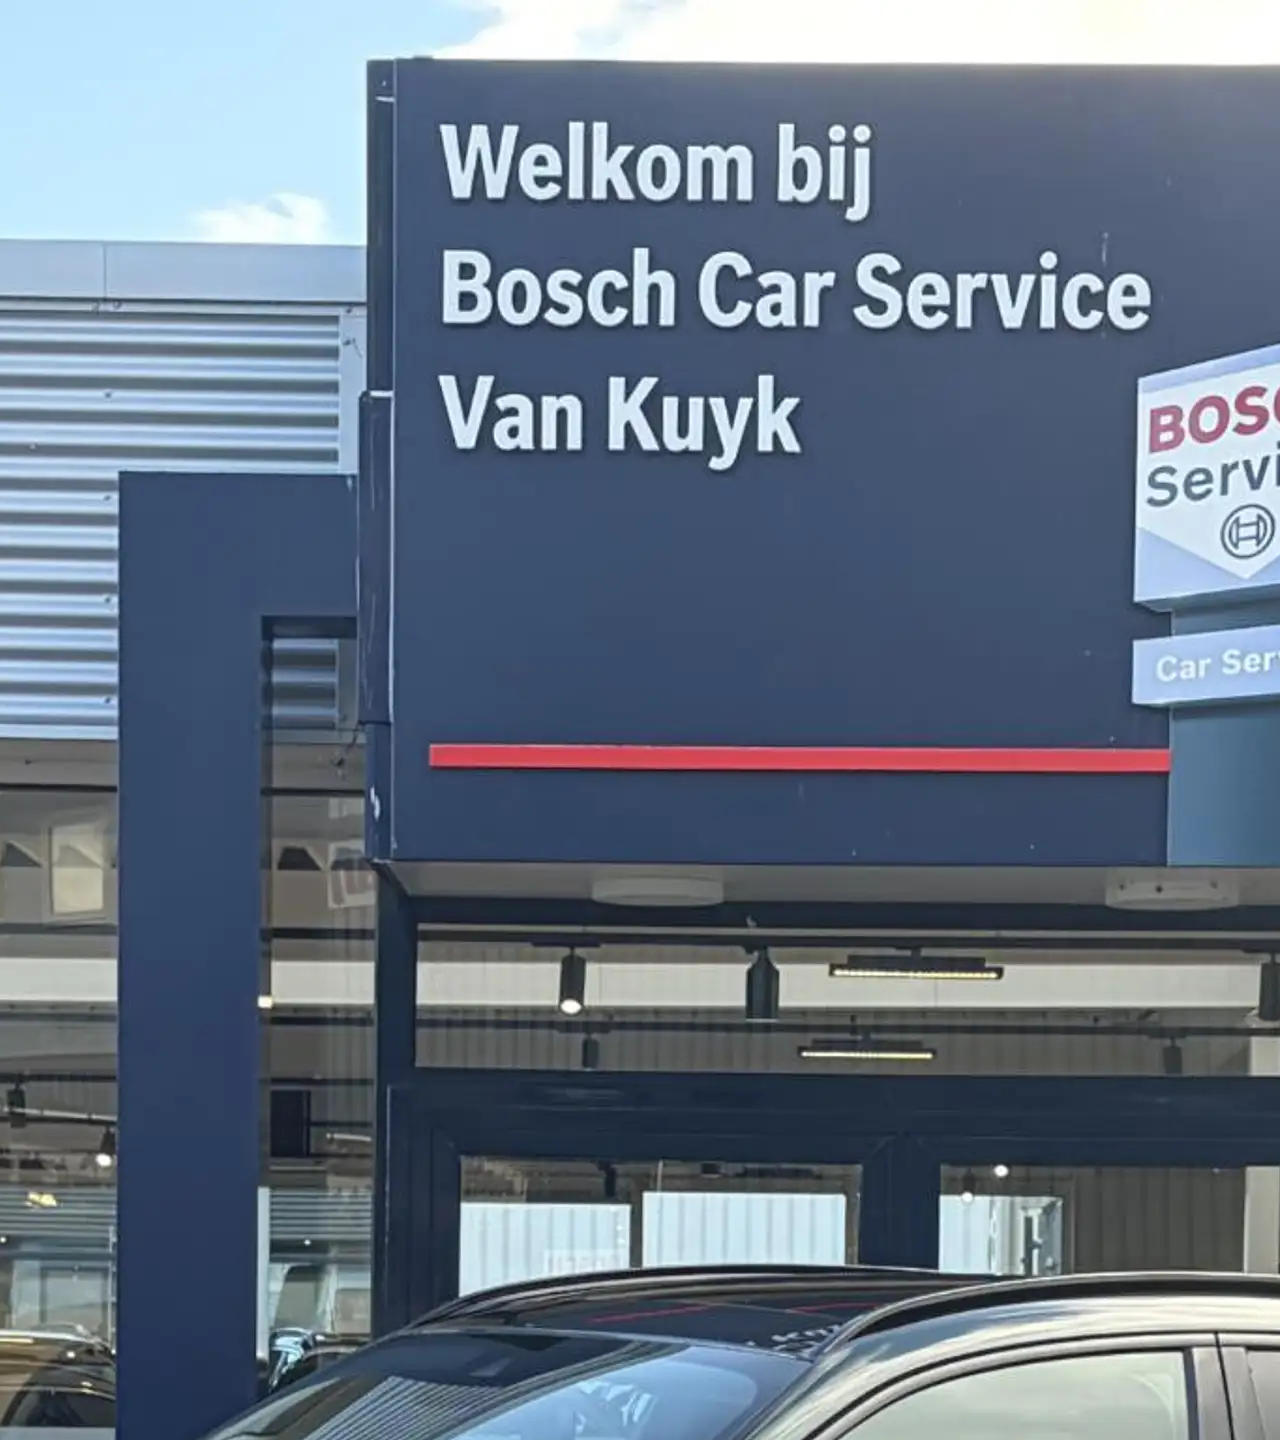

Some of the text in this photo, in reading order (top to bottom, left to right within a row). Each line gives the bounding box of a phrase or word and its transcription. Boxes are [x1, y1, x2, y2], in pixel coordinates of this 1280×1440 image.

[439, 122, 873, 222] Welkom bij
[440, 248, 1152, 330] Bosch Car Service
[438, 375, 802, 471] Van Kuyk
[1156, 654, 1211, 683] Car
